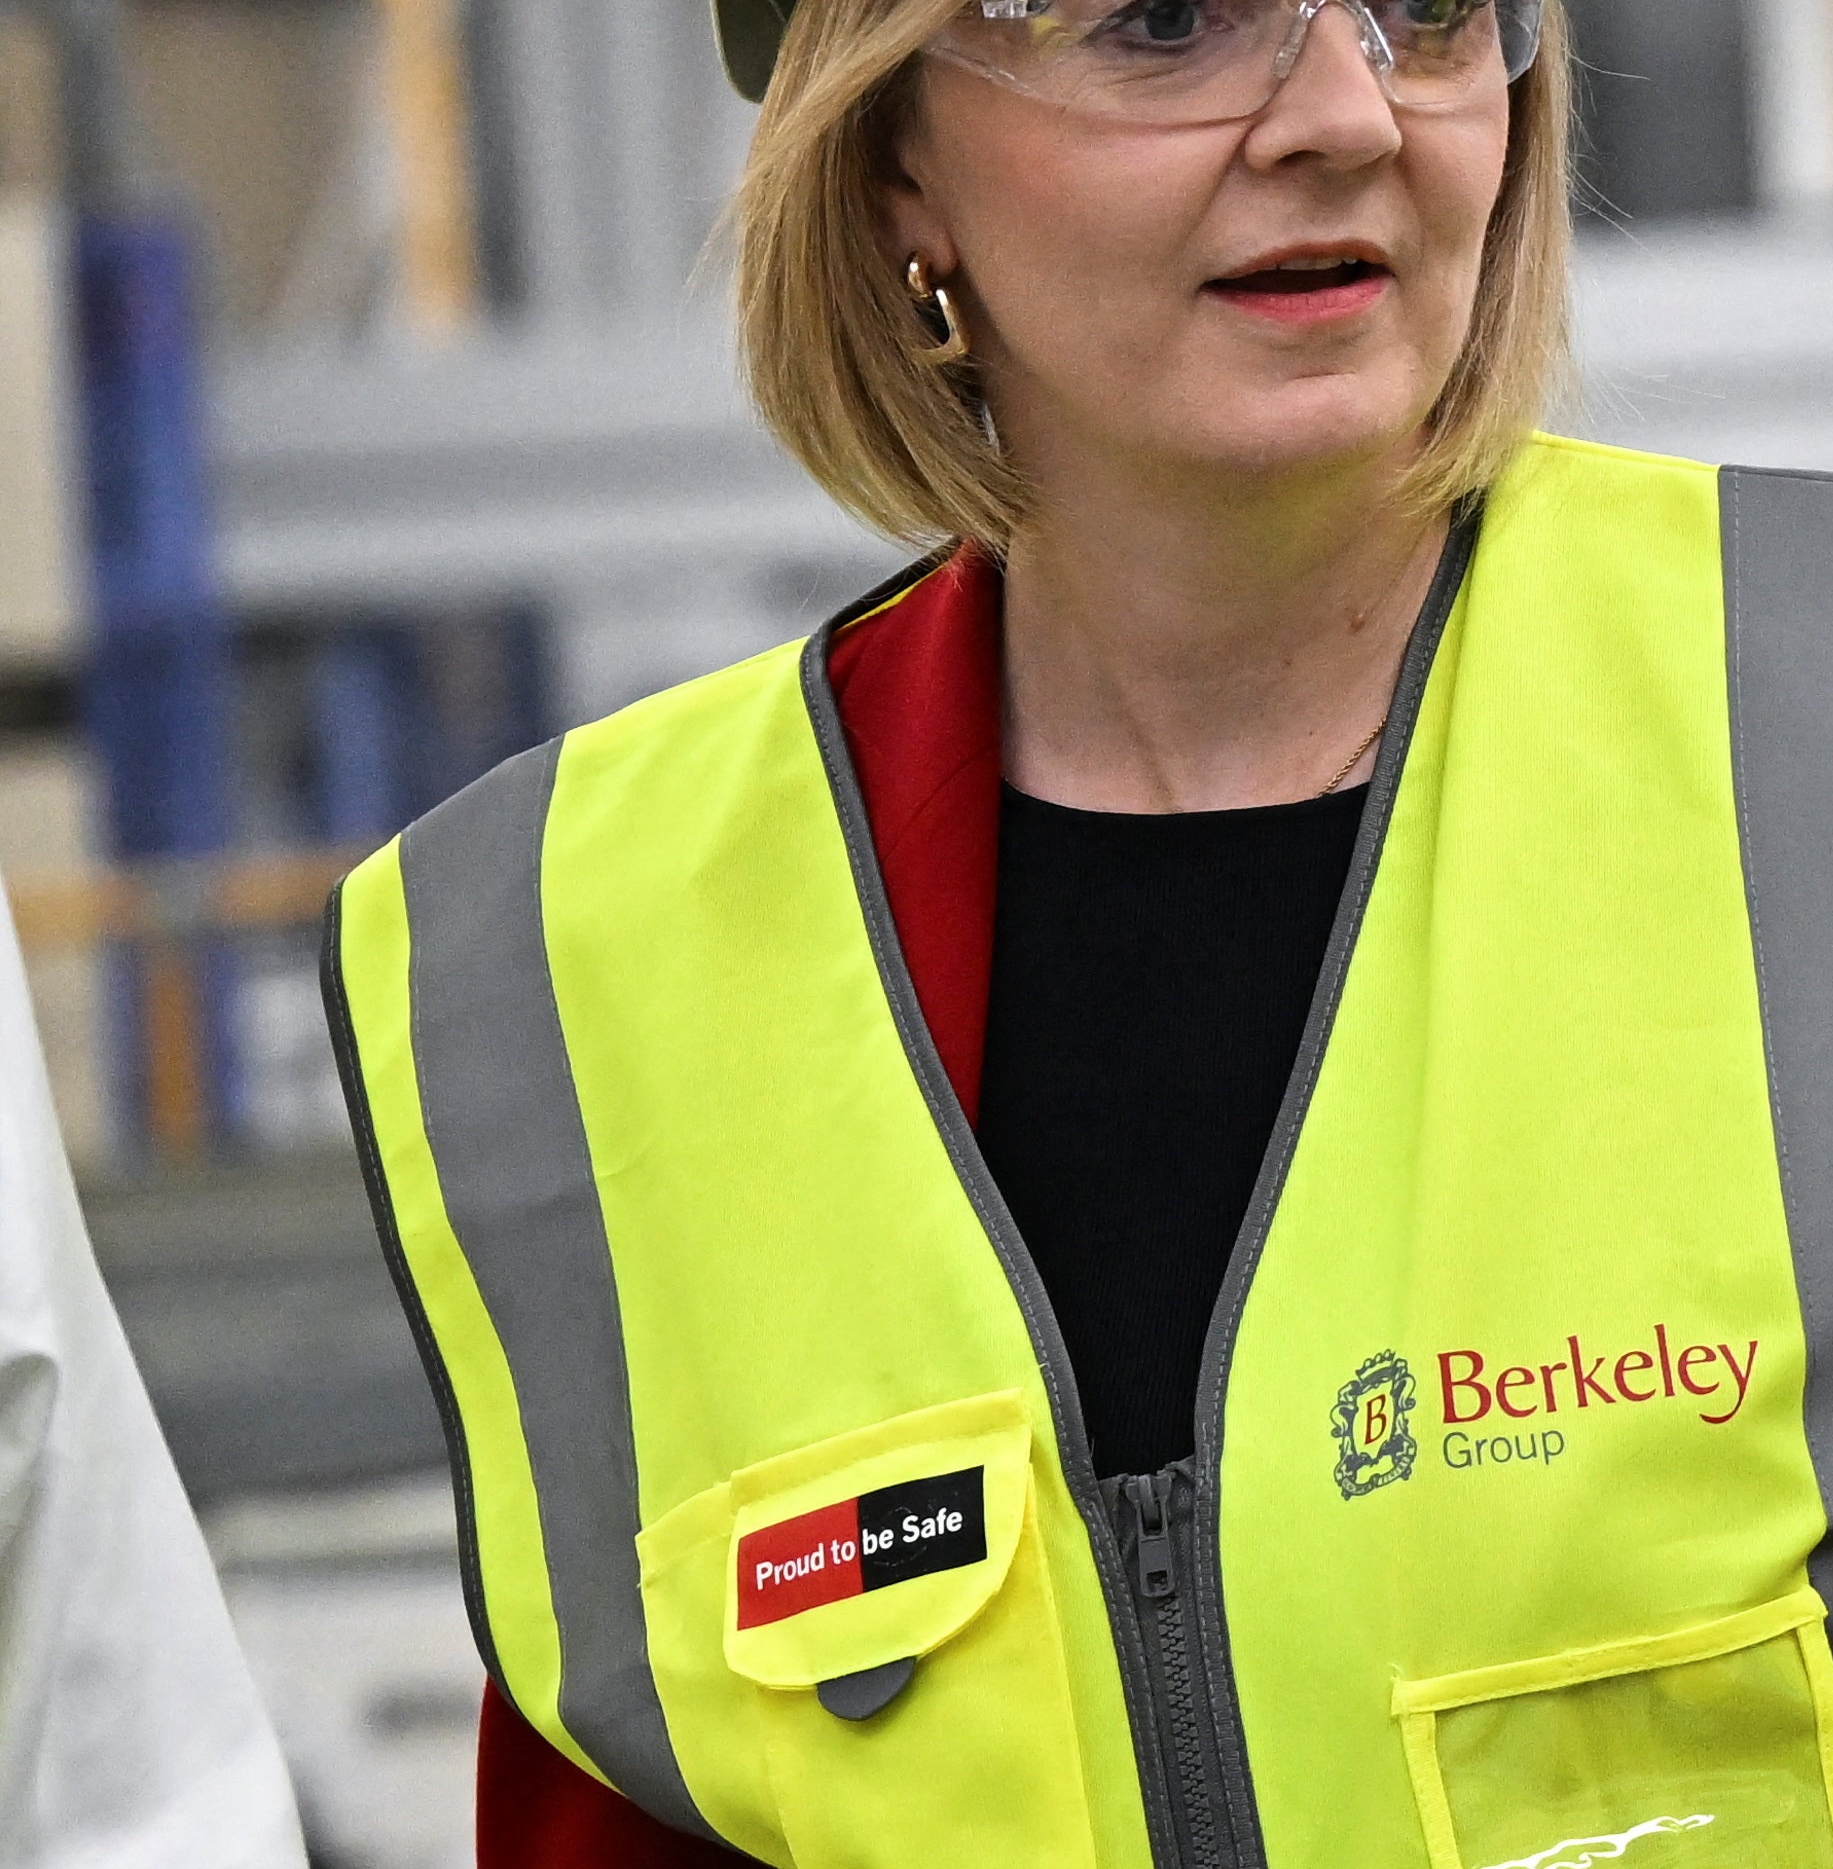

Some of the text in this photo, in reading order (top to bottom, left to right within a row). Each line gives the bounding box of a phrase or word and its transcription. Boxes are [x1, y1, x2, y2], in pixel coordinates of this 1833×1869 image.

[1436, 1322, 1759, 1425] Berkeley
[1364, 1393, 1387, 1446] B
[1442, 1429, 1566, 1469] Group
[755, 1507, 964, 1591] Proud to be Safe
